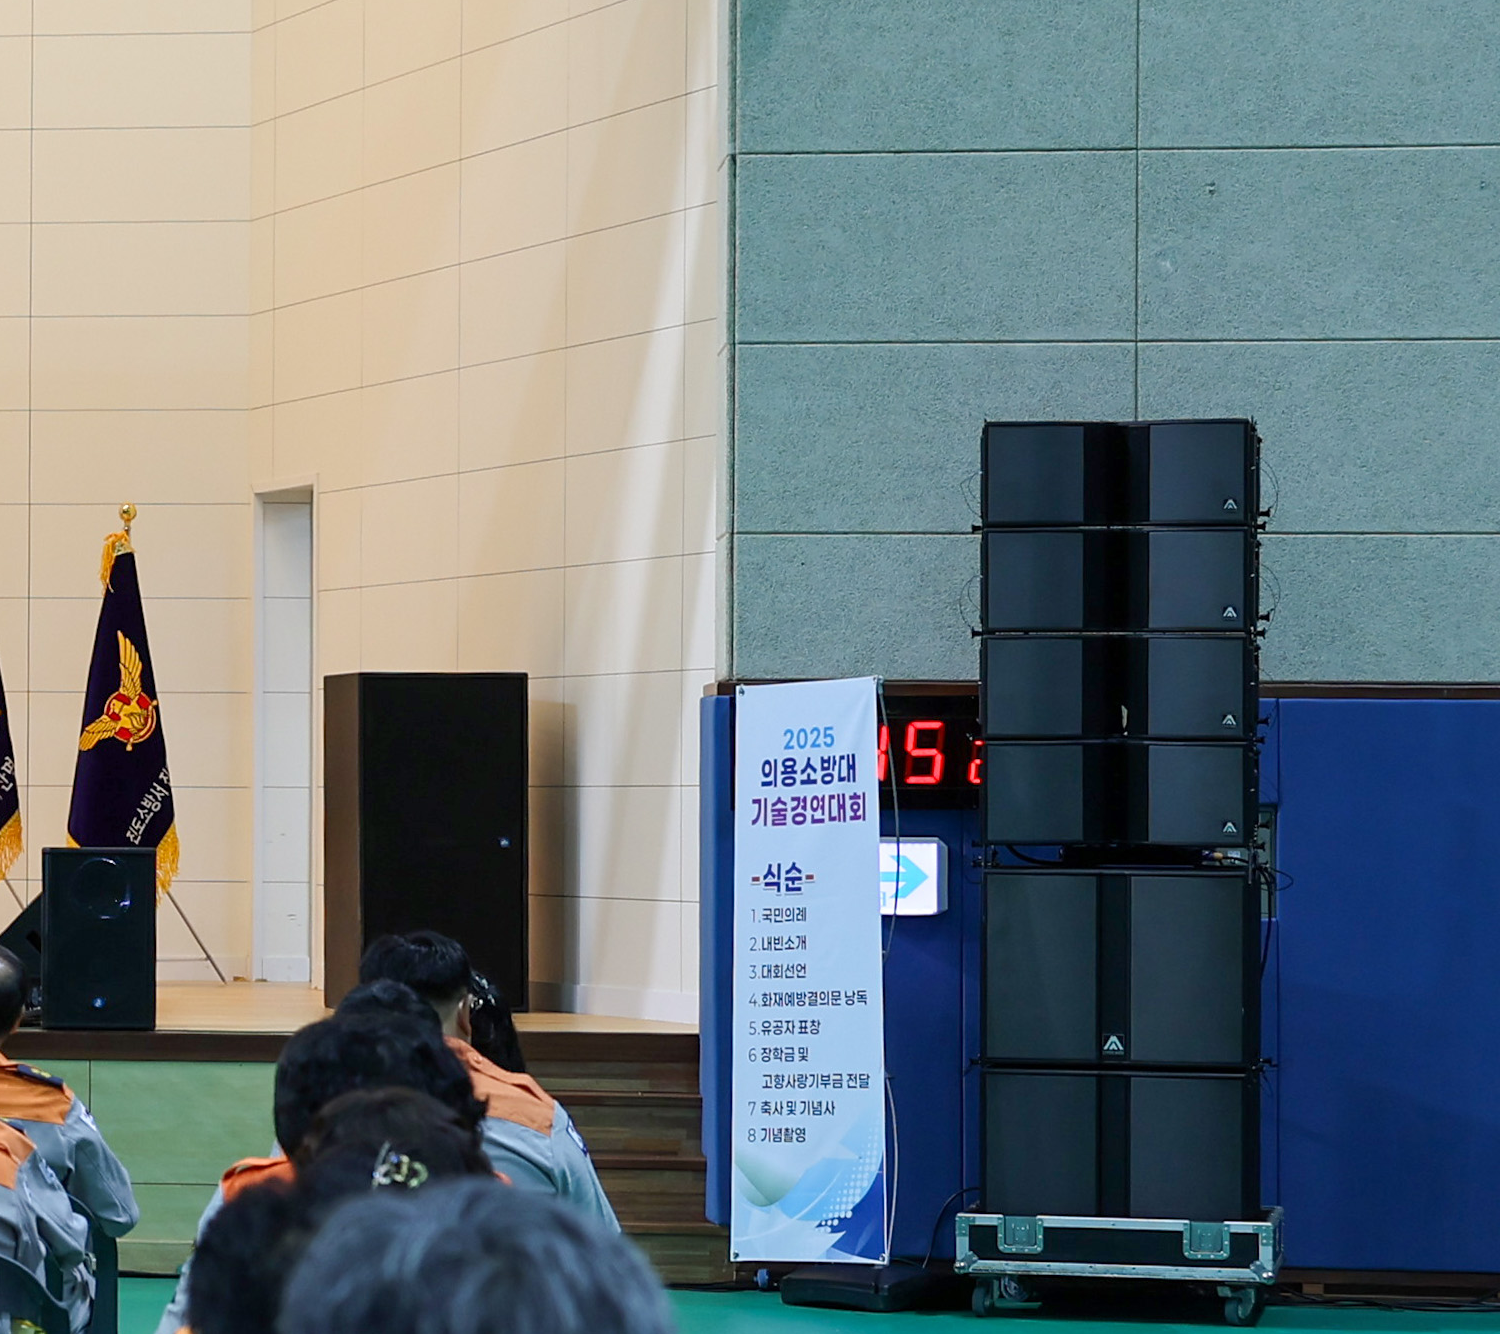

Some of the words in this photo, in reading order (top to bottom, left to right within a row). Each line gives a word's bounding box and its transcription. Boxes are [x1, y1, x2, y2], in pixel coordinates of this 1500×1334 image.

[783, 726, 835, 750] 2025
[761, 753, 856, 788] 의용소방대
[126, 782, 170, 845] 진도소방서
[751, 792, 866, 827] 기술경연대회
[844, 989, 868, 1006] 낭독
[798, 1019, 821, 1035] 표창
[761, 1047, 796, 1063] 장학금
[798, 1047, 809, 1062] 및
[762, 1073, 844, 1089] 고향사랑기부금
[846, 1073, 870, 1089] 전달
[760, 1100, 784, 1116] 축사
[786, 1100, 797, 1116] 및
[799, 1100, 836, 1116] 기념사
[760, 1128, 806, 1143] 기념촬영
